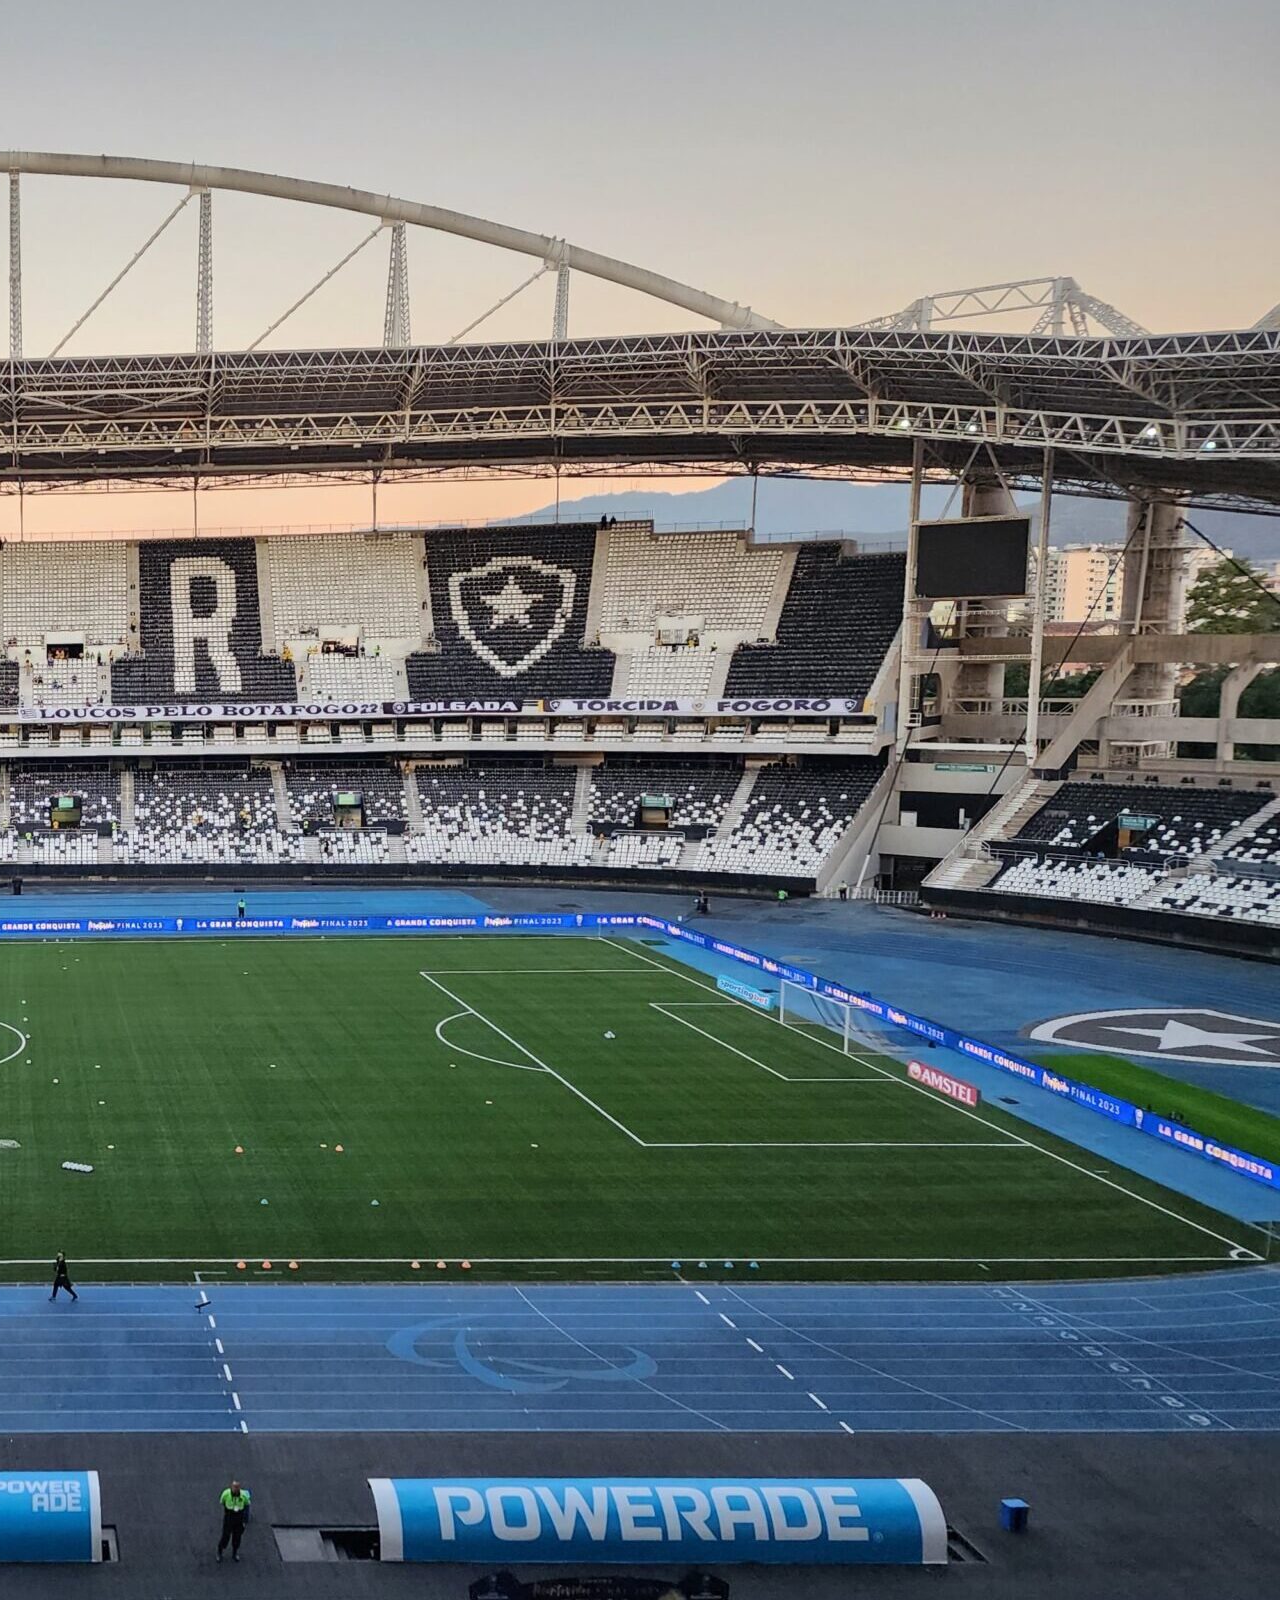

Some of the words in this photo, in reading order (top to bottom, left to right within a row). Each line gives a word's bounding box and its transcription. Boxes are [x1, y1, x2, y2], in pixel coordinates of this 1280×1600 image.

[169, 556, 243, 693] R
[39, 708, 137, 719] LOUCOS
[145, 706, 213, 717] PELO
[406, 701, 519, 713] FOLGADA
[572, 699, 680, 712] TORCIDA
[908, 1019, 927, 1034] FINAL
[958, 1040, 964, 1049] A
[965, 1042, 993, 1061] GRANDE
[993, 1054, 1036, 1079] CONQUISTA
[922, 1068, 975, 1107] AMSTEL
[1070, 1086, 1097, 1106] FINAL
[1098, 1098, 1121, 1115] 2023
[1158, 1123, 1172, 1137] LA
[1173, 1130, 1204, 1151] GRAN
[1204, 1142, 1273, 1180] CONQUISTA
[1012, 1302, 1034, 1311] 2
[1034, 1316, 1055, 1326] 3
[1132, 1378, 1151, 1390] 7
[1160, 1395, 1185, 1408] 8
[1188, 1413, 1211, 1426] 9
[31, 1493, 82, 1513] ADE
[432, 1486, 869, 1542] POWERADE
